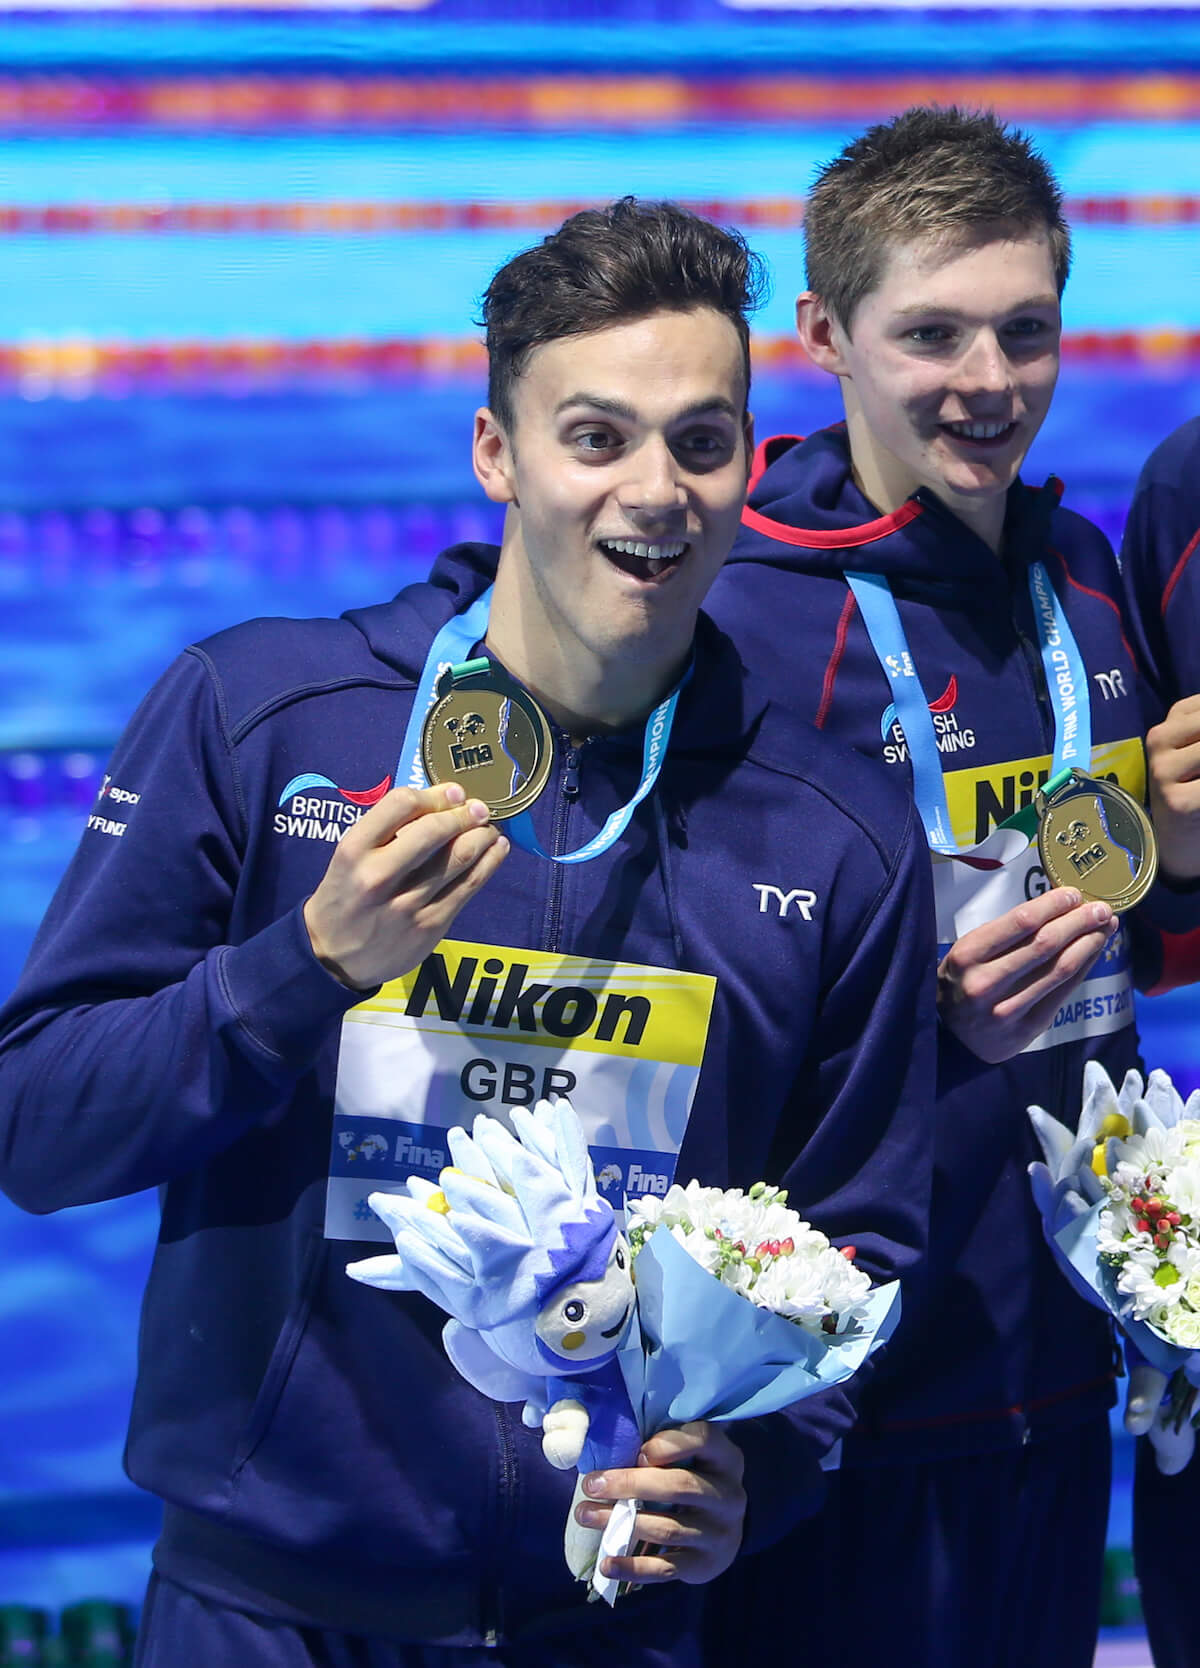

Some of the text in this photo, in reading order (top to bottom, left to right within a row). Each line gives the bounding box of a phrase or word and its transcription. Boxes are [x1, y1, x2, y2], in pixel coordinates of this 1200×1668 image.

[1033, 564, 1063, 647] CHAMPIO
[1052, 650, 1075, 709] WORLD
[1093, 668, 1128, 701] TYR
[1063, 710, 1078, 742] FINA
[448, 743, 493, 769] Fina
[273, 814, 352, 842] SWIMM
[752, 884, 817, 921] TYR
[404, 953, 651, 1046] Nikon
[460, 1058, 578, 1105] GBR
[395, 1136, 668, 1194] Fina Fina
